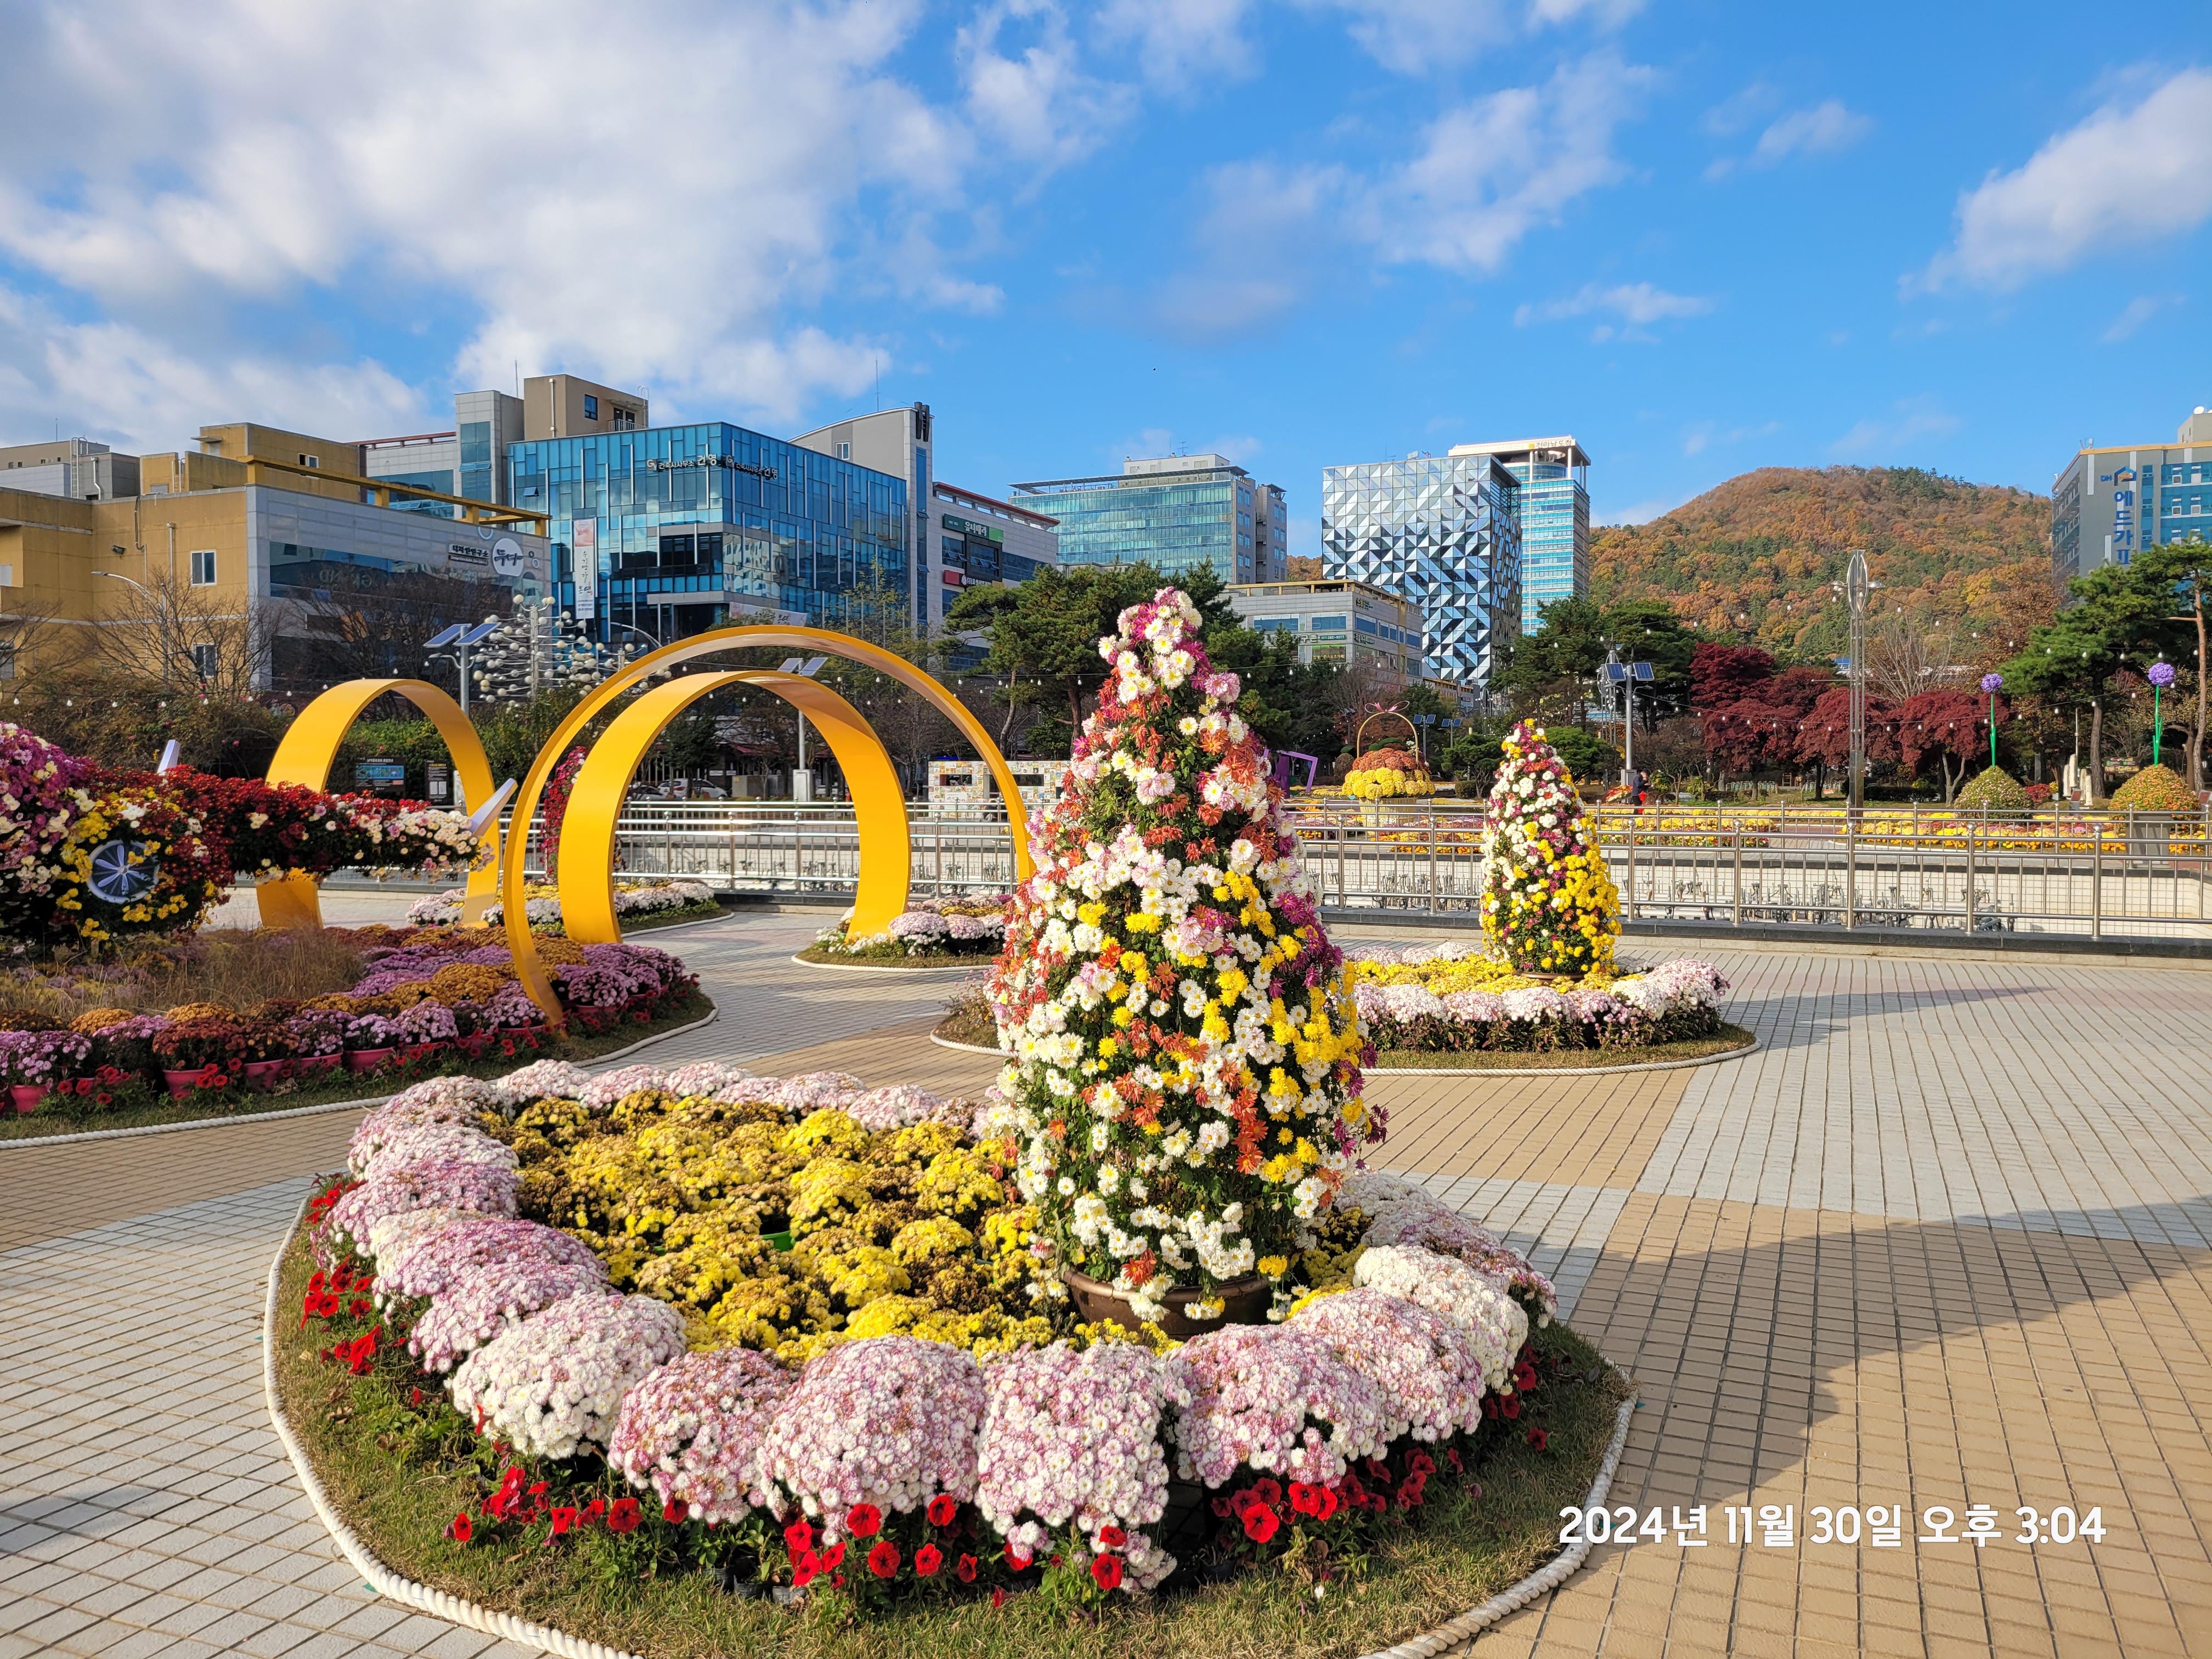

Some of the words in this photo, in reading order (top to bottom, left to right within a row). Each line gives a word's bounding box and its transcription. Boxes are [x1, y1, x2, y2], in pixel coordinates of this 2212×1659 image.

[658, 460, 695, 470] 건축사사무소
[697, 454, 717, 466] 건영
[764, 466, 778, 480] 건영
